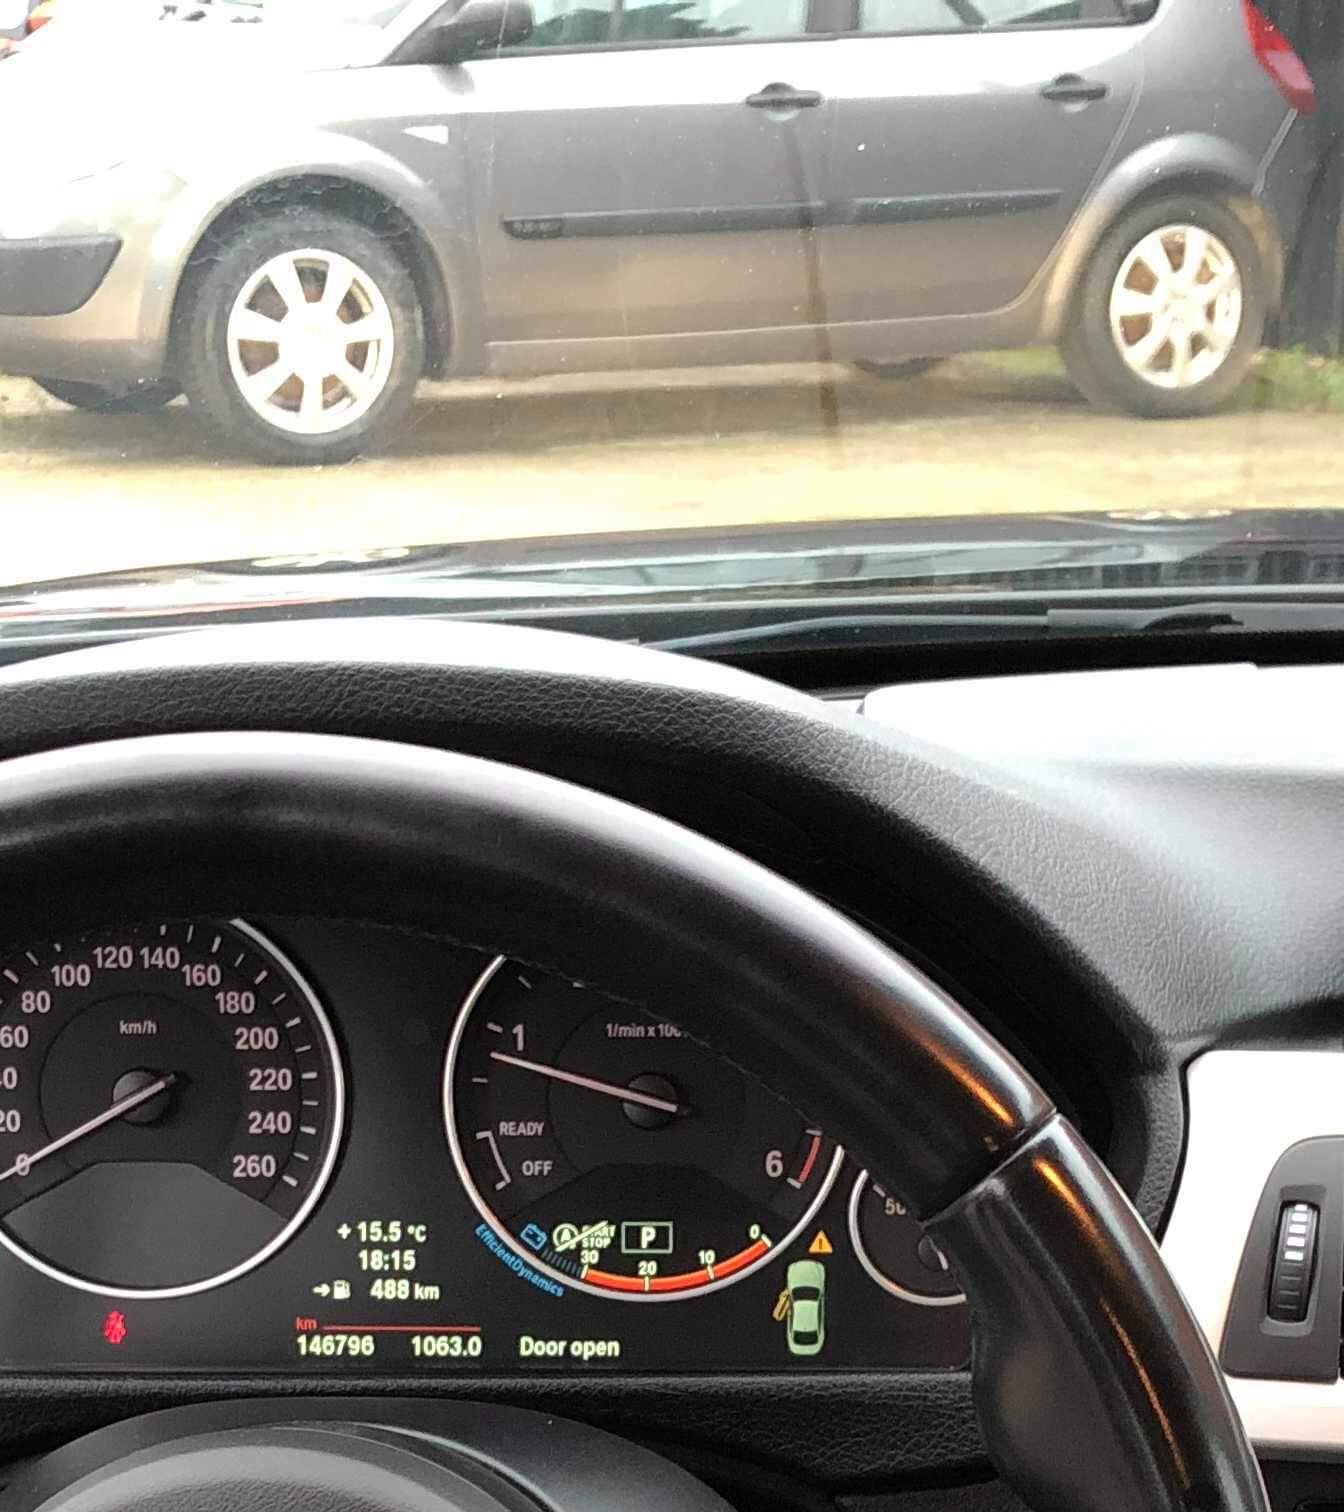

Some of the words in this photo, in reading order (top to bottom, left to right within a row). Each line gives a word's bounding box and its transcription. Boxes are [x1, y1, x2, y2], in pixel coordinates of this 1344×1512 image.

[93, 946, 134, 970] 120
[140, 946, 181, 970] 140
[50, 964, 92, 988] 100
[182, 964, 221, 987] 160
[21, 991, 51, 1014] 80
[215, 991, 256, 1015] 180
[119, 1019, 157, 1035] km/h
[510, 1024, 526, 1052] 1
[235, 1027, 279, 1051] 200
[248, 1067, 293, 1092] 220
[248, 1111, 292, 1135] 240
[499, 1120, 544, 1138] READY
[233, 1154, 276, 1179] 260
[521, 1160, 554, 1177] OFF
[764, 1151, 784, 1178] 6
[357, 1220, 402, 1243] 15.5
[641, 1226, 656, 1250] P
[749, 1224, 761, 1239] 0
[358, 1249, 416, 1271] 18:15
[580, 1250, 600, 1264] 30
[638, 1260, 657, 1275] 20
[699, 1249, 716, 1264] 10
[370, 1278, 410, 1301] 488
[414, 1281, 441, 1301] km
[296, 1316, 318, 1331] km
[296, 1335, 375, 1356] 146796
[411, 1335, 483, 1357] 1063.0
[520, 1336, 566, 1357] Door
[570, 1341, 621, 1360] open
